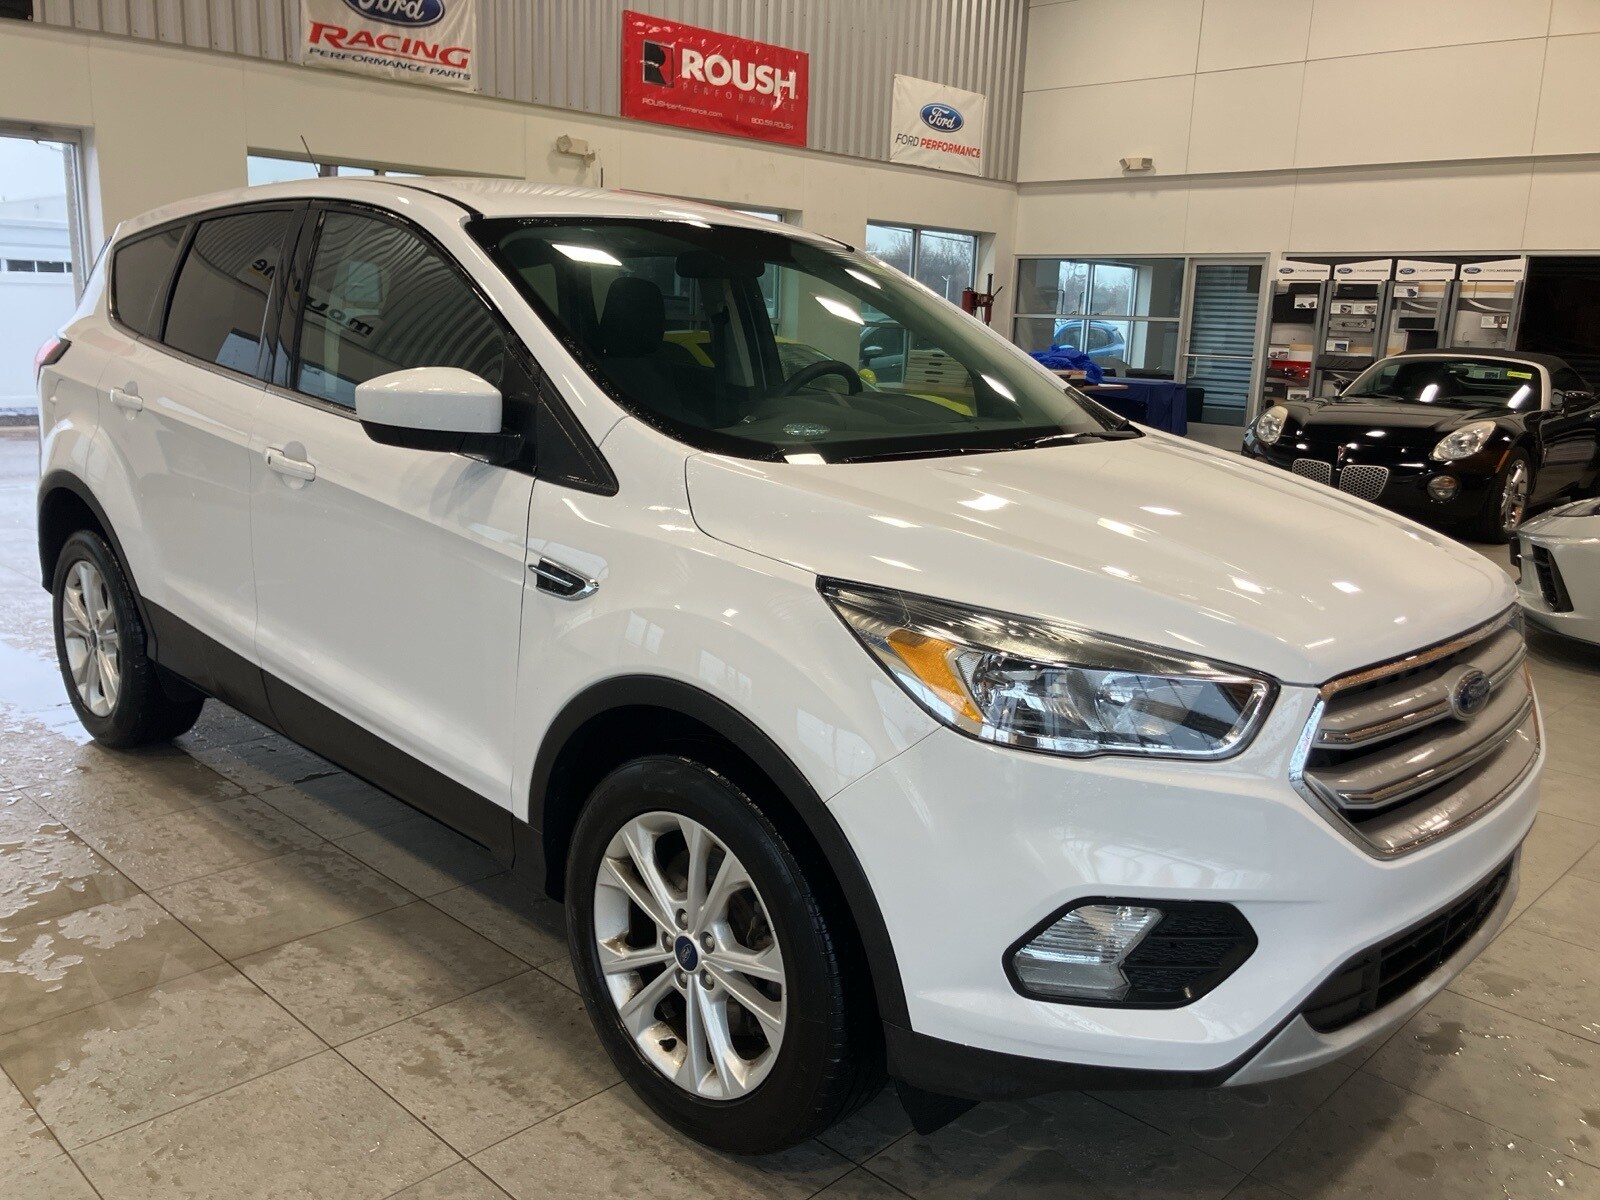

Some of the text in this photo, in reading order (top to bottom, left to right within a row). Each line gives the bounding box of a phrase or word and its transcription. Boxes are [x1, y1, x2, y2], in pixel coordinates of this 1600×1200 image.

[358, 0, 424, 20] ord
[309, 21, 471, 69] RACING
[309, 47, 471, 81] PERFORMANCE PARTS
[682, 49, 796, 99] ROUSH
[928, 107, 957, 129] Ford
[895, 133, 980, 158] FORD PERFORMANCE
